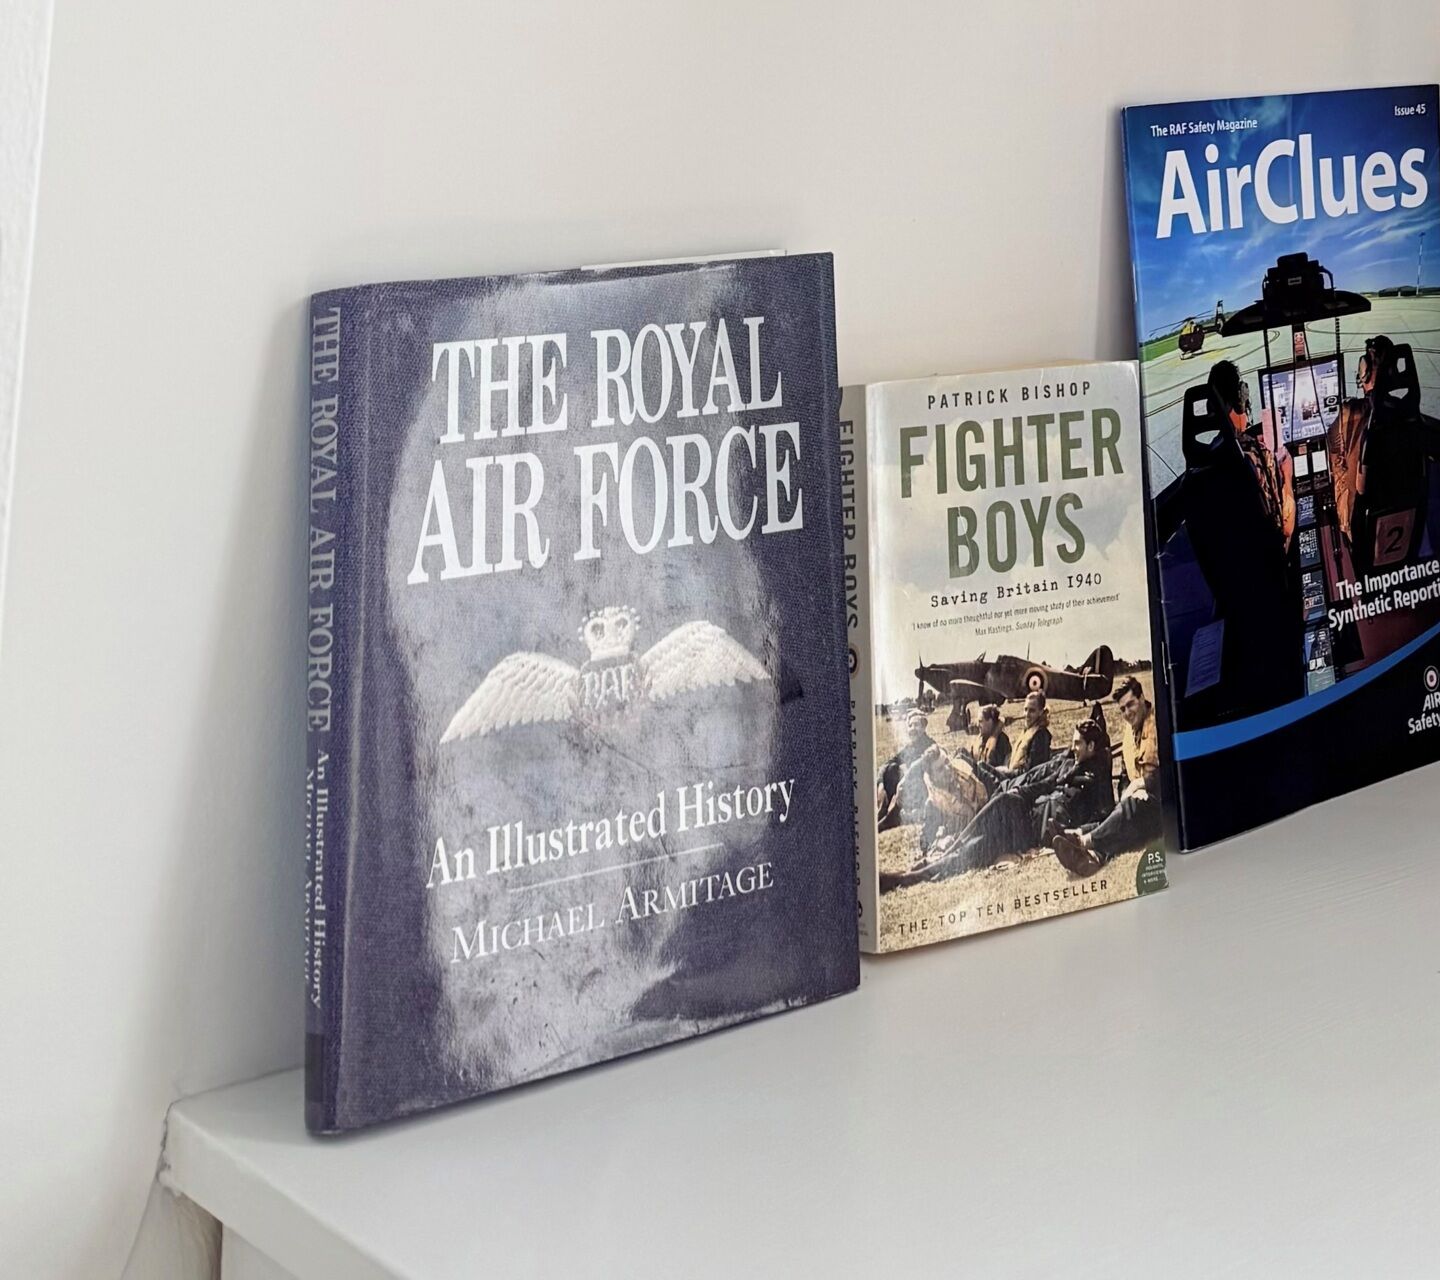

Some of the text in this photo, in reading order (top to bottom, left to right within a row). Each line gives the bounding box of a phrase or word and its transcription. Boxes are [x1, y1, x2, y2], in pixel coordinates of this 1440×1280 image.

[1150, 118, 1258, 137] The RAF Safety Magazine
[1394, 103, 1426, 117] Issue 45
[1155, 133, 1429, 239] AirClues
[432, 316, 783, 443] THE ROYAL
[928, 381, 1091, 410] PATRICK BISHOP
[900, 408, 1124, 499] FIGHTER
[407, 421, 803, 584] AIR FORCE
[947, 492, 1087, 579] BOYS
[1386, 526, 1404, 554] 2
[930, 573, 1102, 608] Saving Britain 1940
[1336, 579, 1362, 600] The
[1364, 559, 1440, 593] Importance
[1328, 594, 1392, 631] Synthetic
[306, 307, 341, 1009] THE ROYAL AIR FORCE An Illustrated History
[426, 778, 795, 889] An Illustrated History
[1147, 851, 1164, 864] P.S.
[450, 862, 774, 964] MICHAEL ARMITAGE
[899, 879, 1109, 936] THE TOP TEN BESTSELLER
